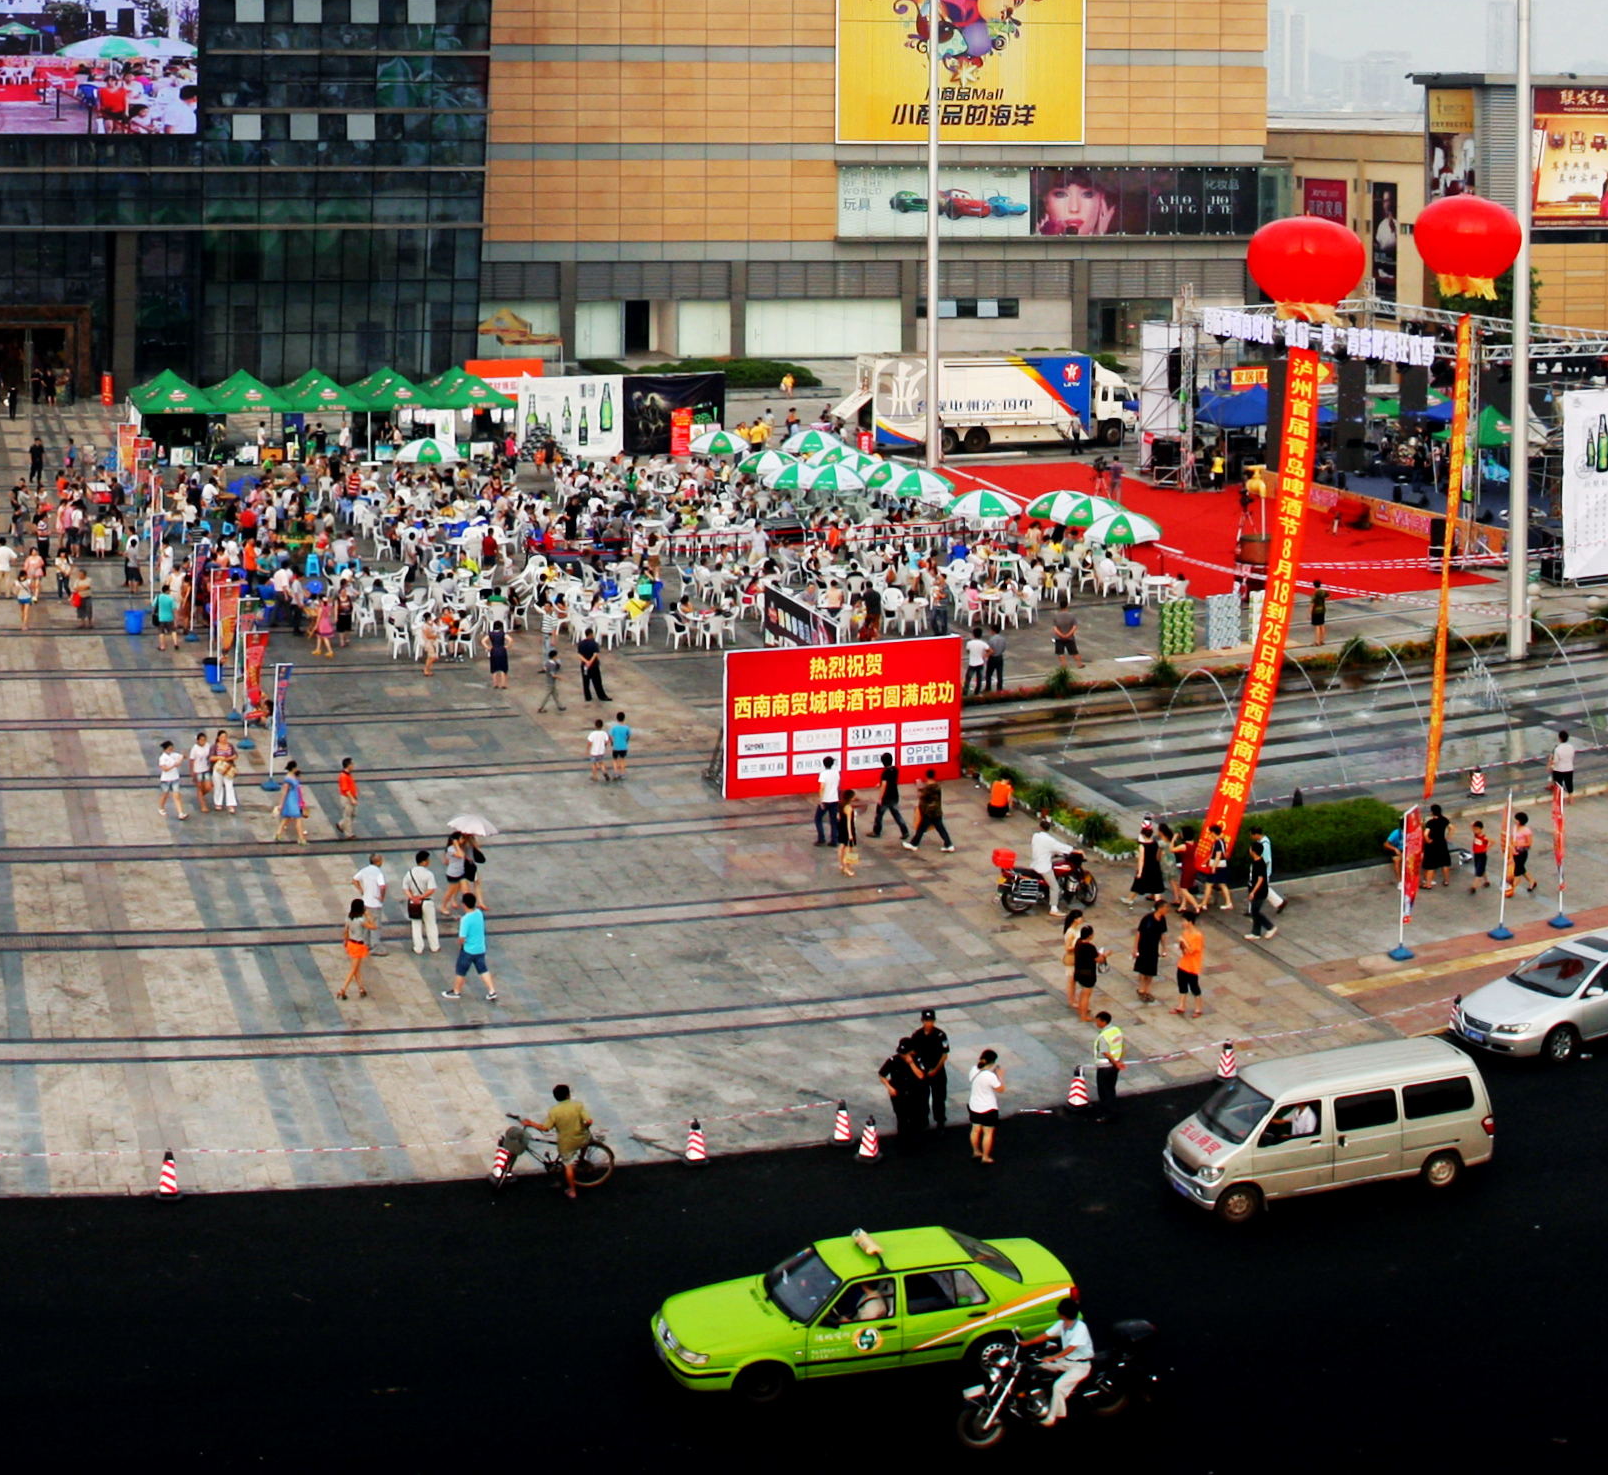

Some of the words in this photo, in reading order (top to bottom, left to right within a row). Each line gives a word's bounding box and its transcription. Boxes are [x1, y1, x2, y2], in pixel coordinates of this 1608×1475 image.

[808, 653, 884, 681] 热烈祝贺
[733, 680, 955, 720] 西南商贸城啤酒节圆满成功
[851, 726, 872, 741] 3D
[906, 743, 944, 755] OPPLE
